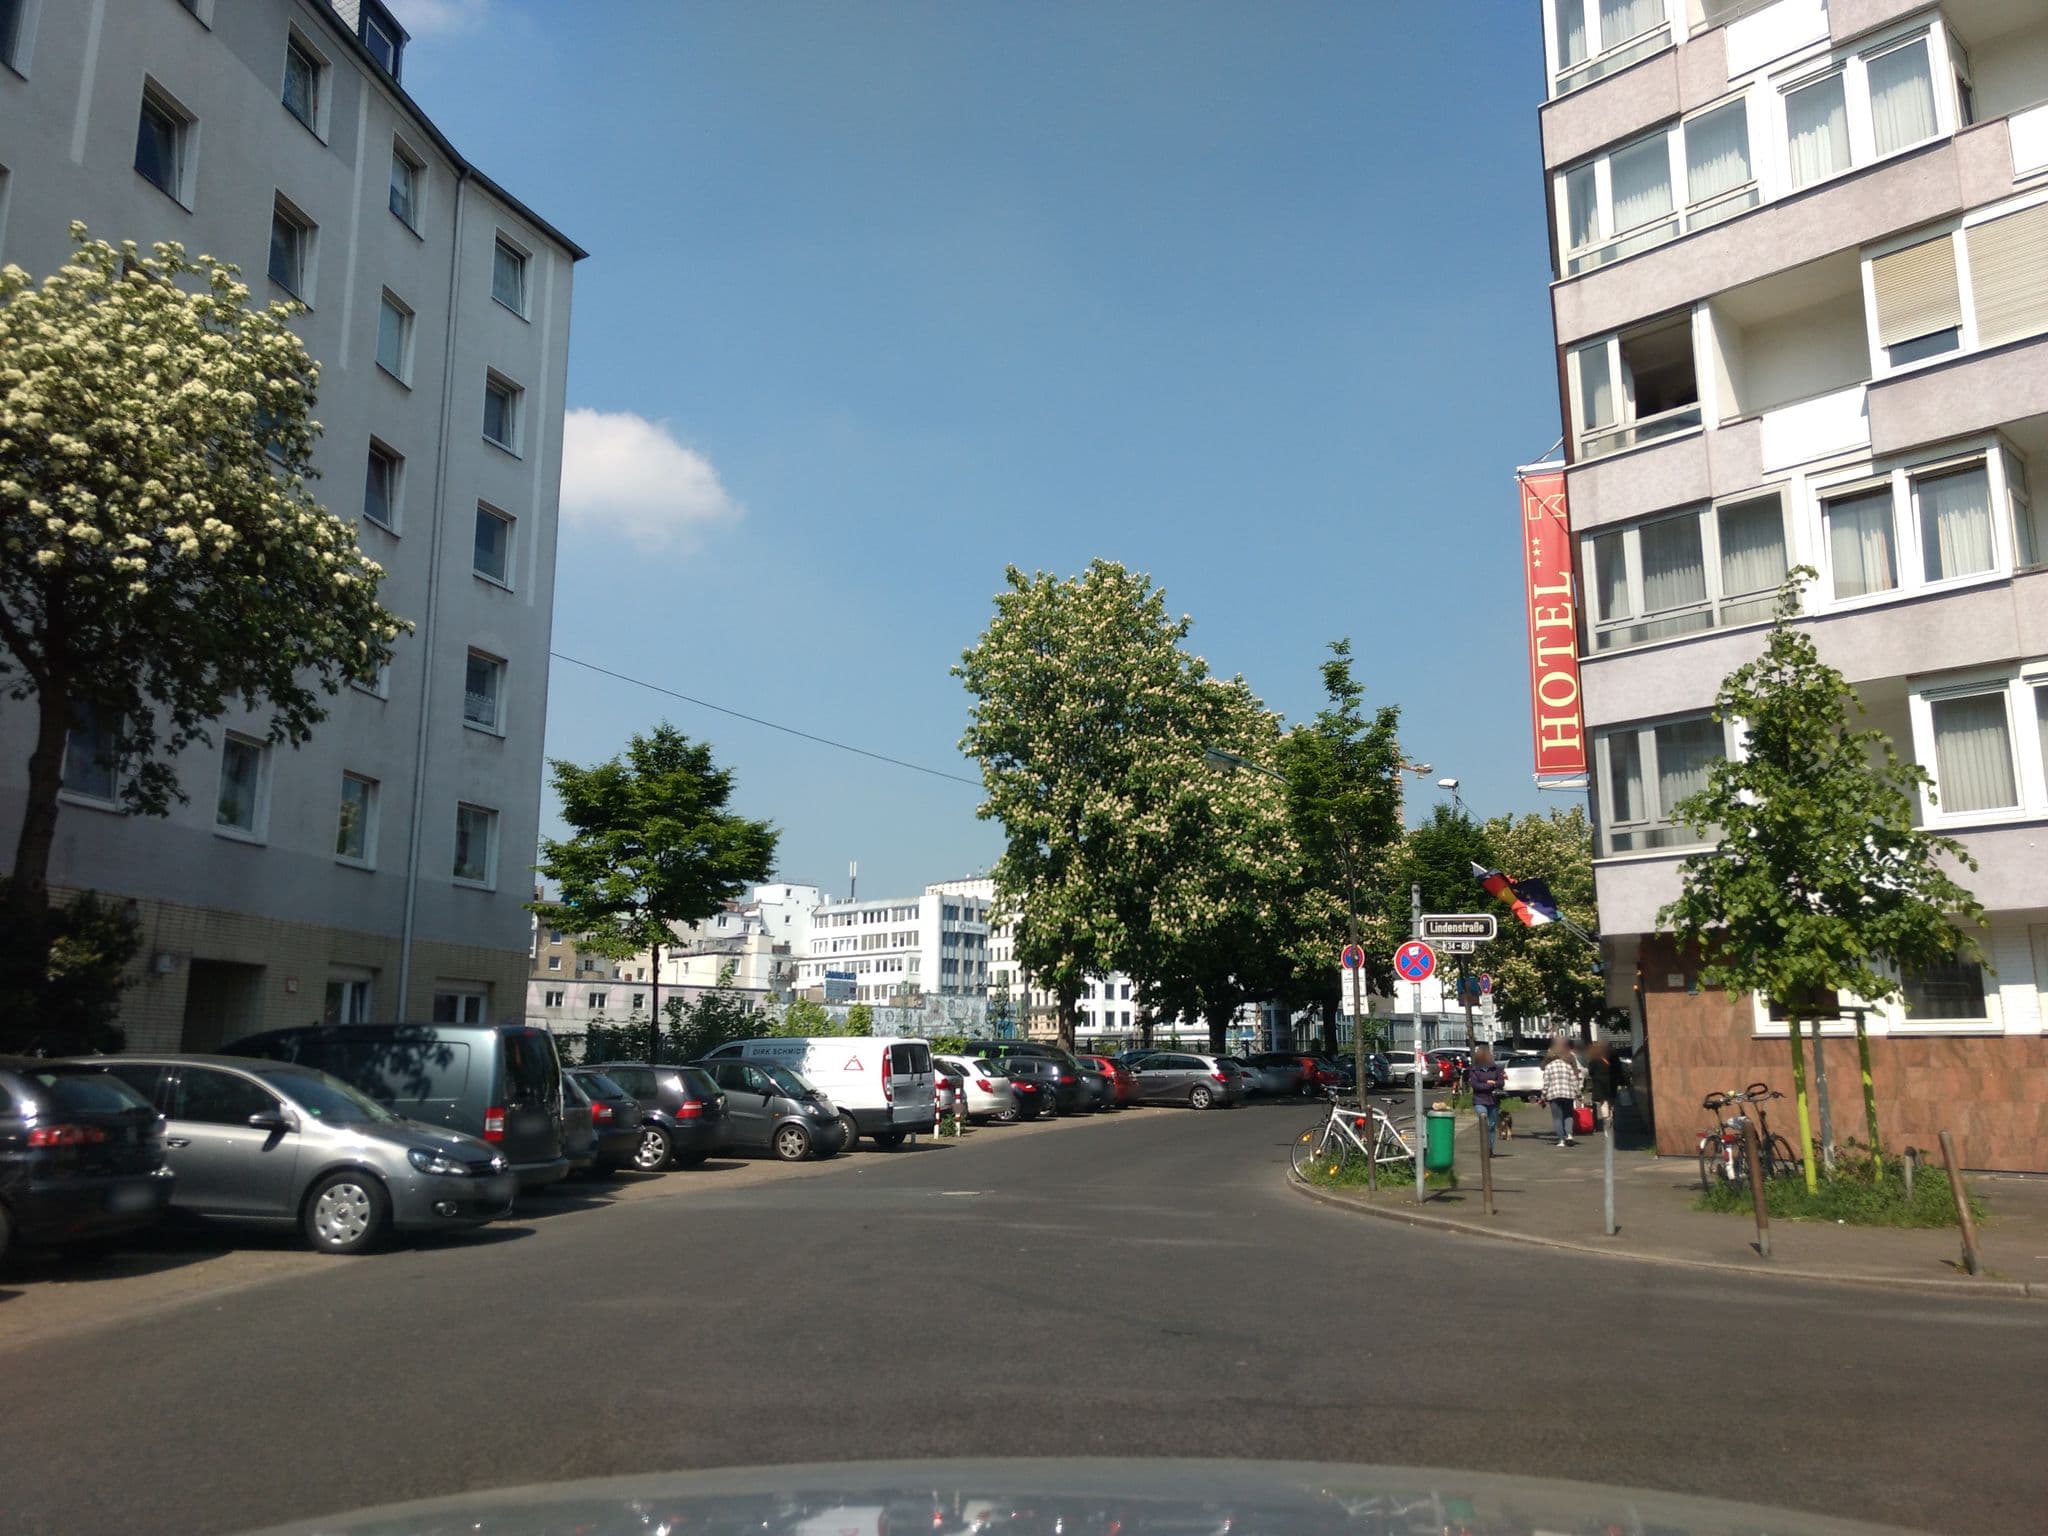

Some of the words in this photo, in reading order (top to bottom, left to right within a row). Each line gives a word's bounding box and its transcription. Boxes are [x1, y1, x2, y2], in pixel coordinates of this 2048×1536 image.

[1533, 571, 1580, 752] HOTEL
[1430, 921, 1484, 933] Lindenstraße
[752, 1048, 770, 1056] DIRK
